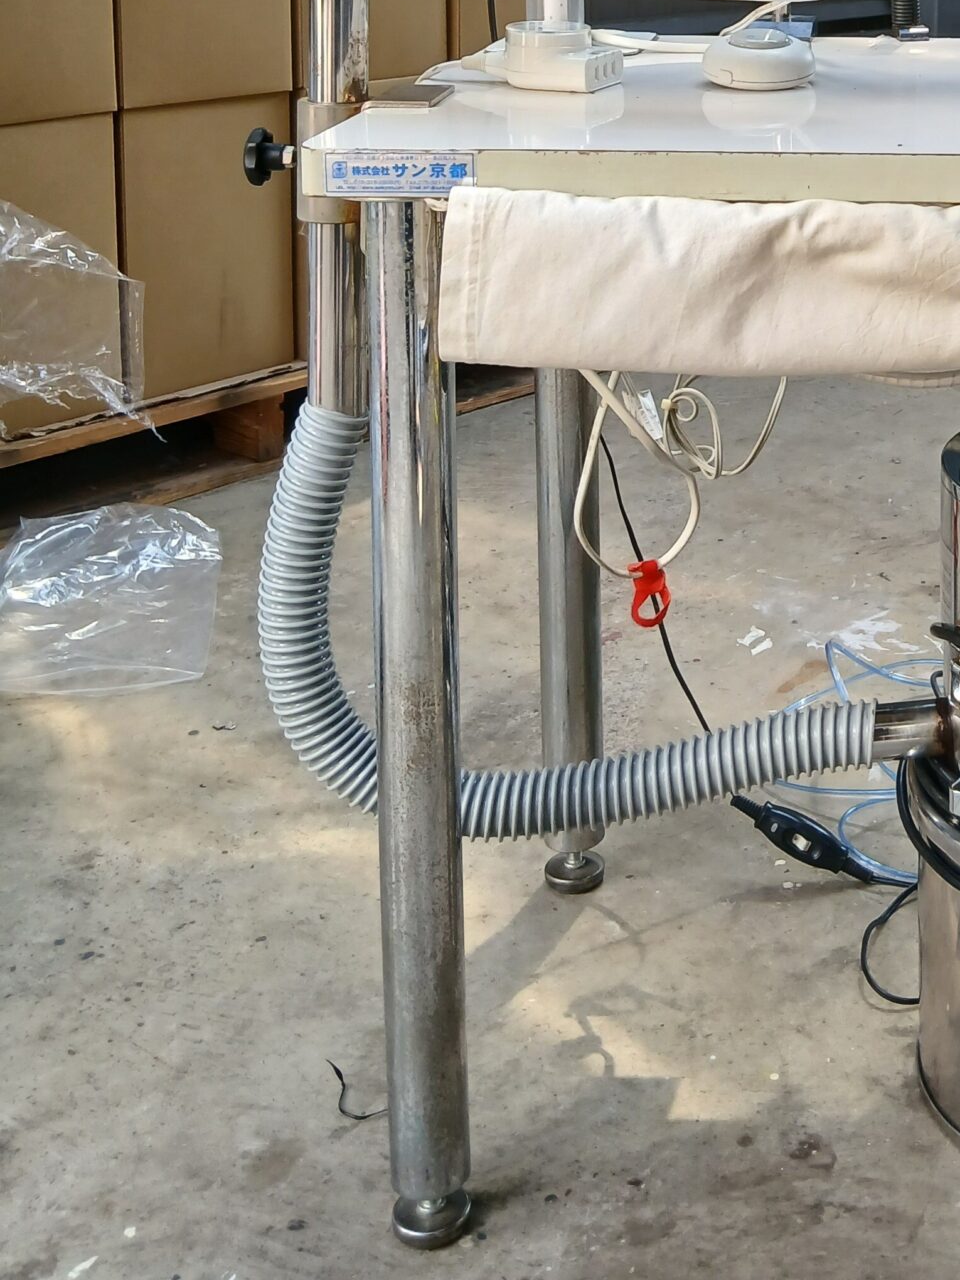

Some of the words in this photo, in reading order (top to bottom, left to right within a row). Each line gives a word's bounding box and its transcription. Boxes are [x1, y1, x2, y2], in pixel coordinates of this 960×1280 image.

[351, 163, 468, 179] 株式会社サン京都
